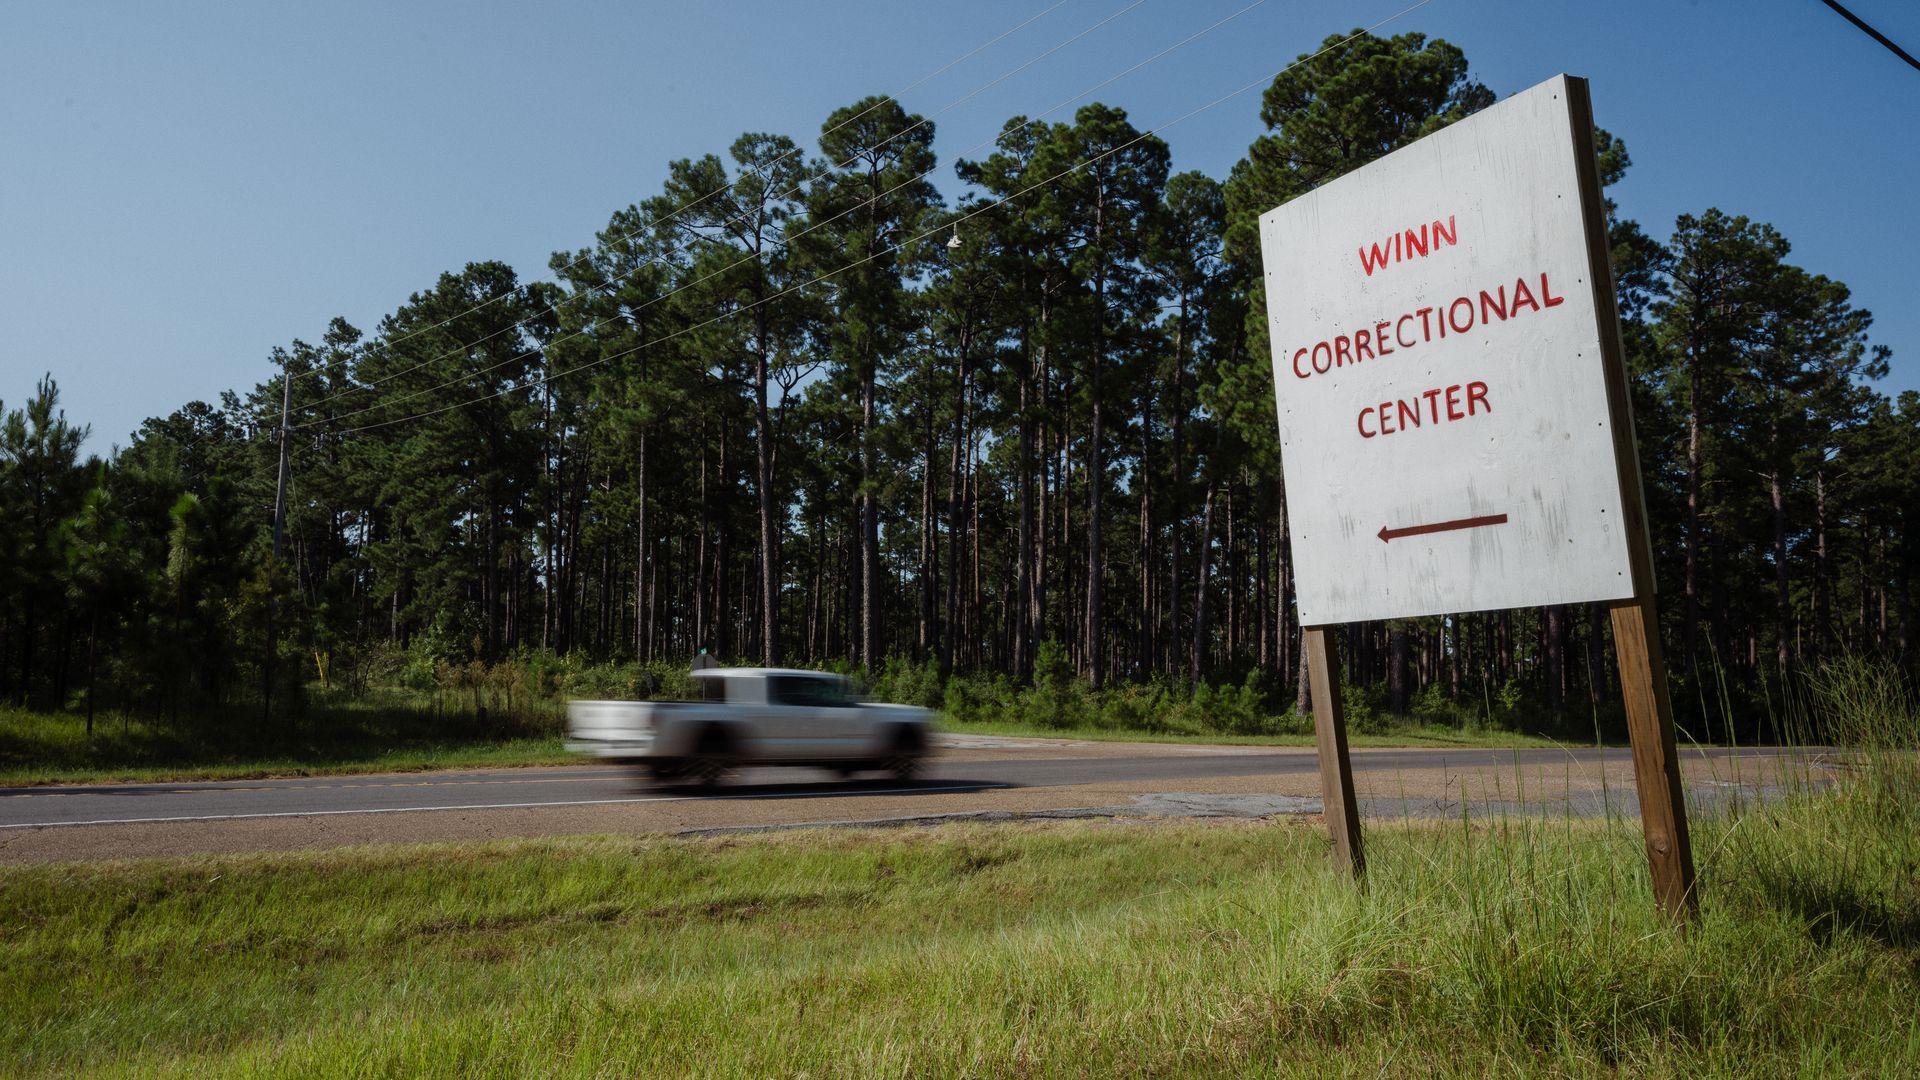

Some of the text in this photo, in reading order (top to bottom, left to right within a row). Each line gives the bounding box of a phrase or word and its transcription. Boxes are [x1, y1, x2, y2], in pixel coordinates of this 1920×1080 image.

[1359, 215, 1458, 276] WINN
[1293, 272, 1565, 379] CORRECTIONAL
[1358, 381, 1492, 439] CENTER
